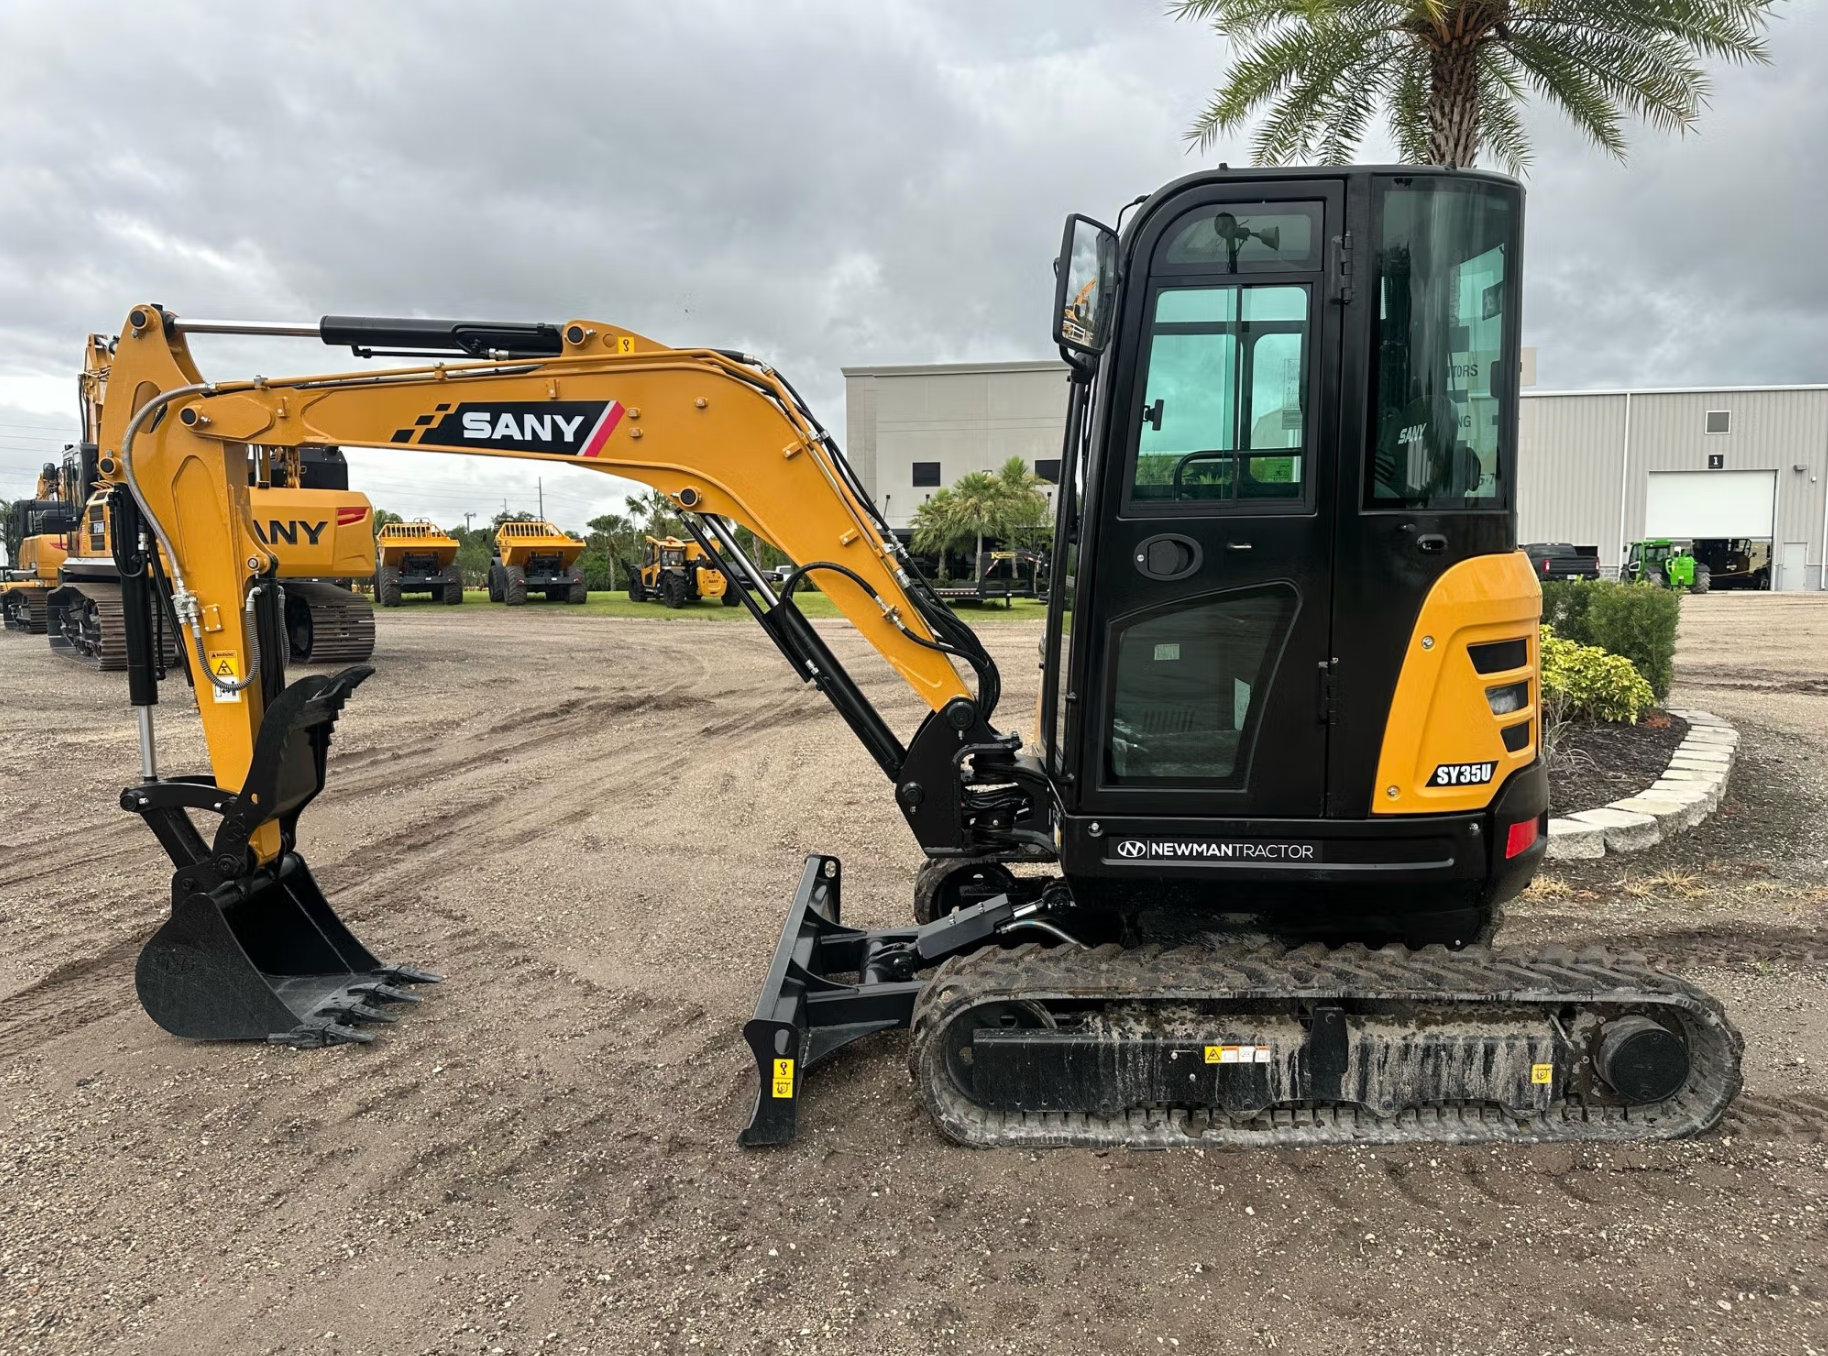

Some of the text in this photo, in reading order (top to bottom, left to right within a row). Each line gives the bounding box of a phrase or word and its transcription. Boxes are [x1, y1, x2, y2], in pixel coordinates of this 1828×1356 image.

[462, 411, 585, 442] SANY
[1398, 422, 1427, 444] SANY
[1437, 763, 1491, 785] SY35U
[1151, 842, 1314, 859] NEWMANTRACTOR
